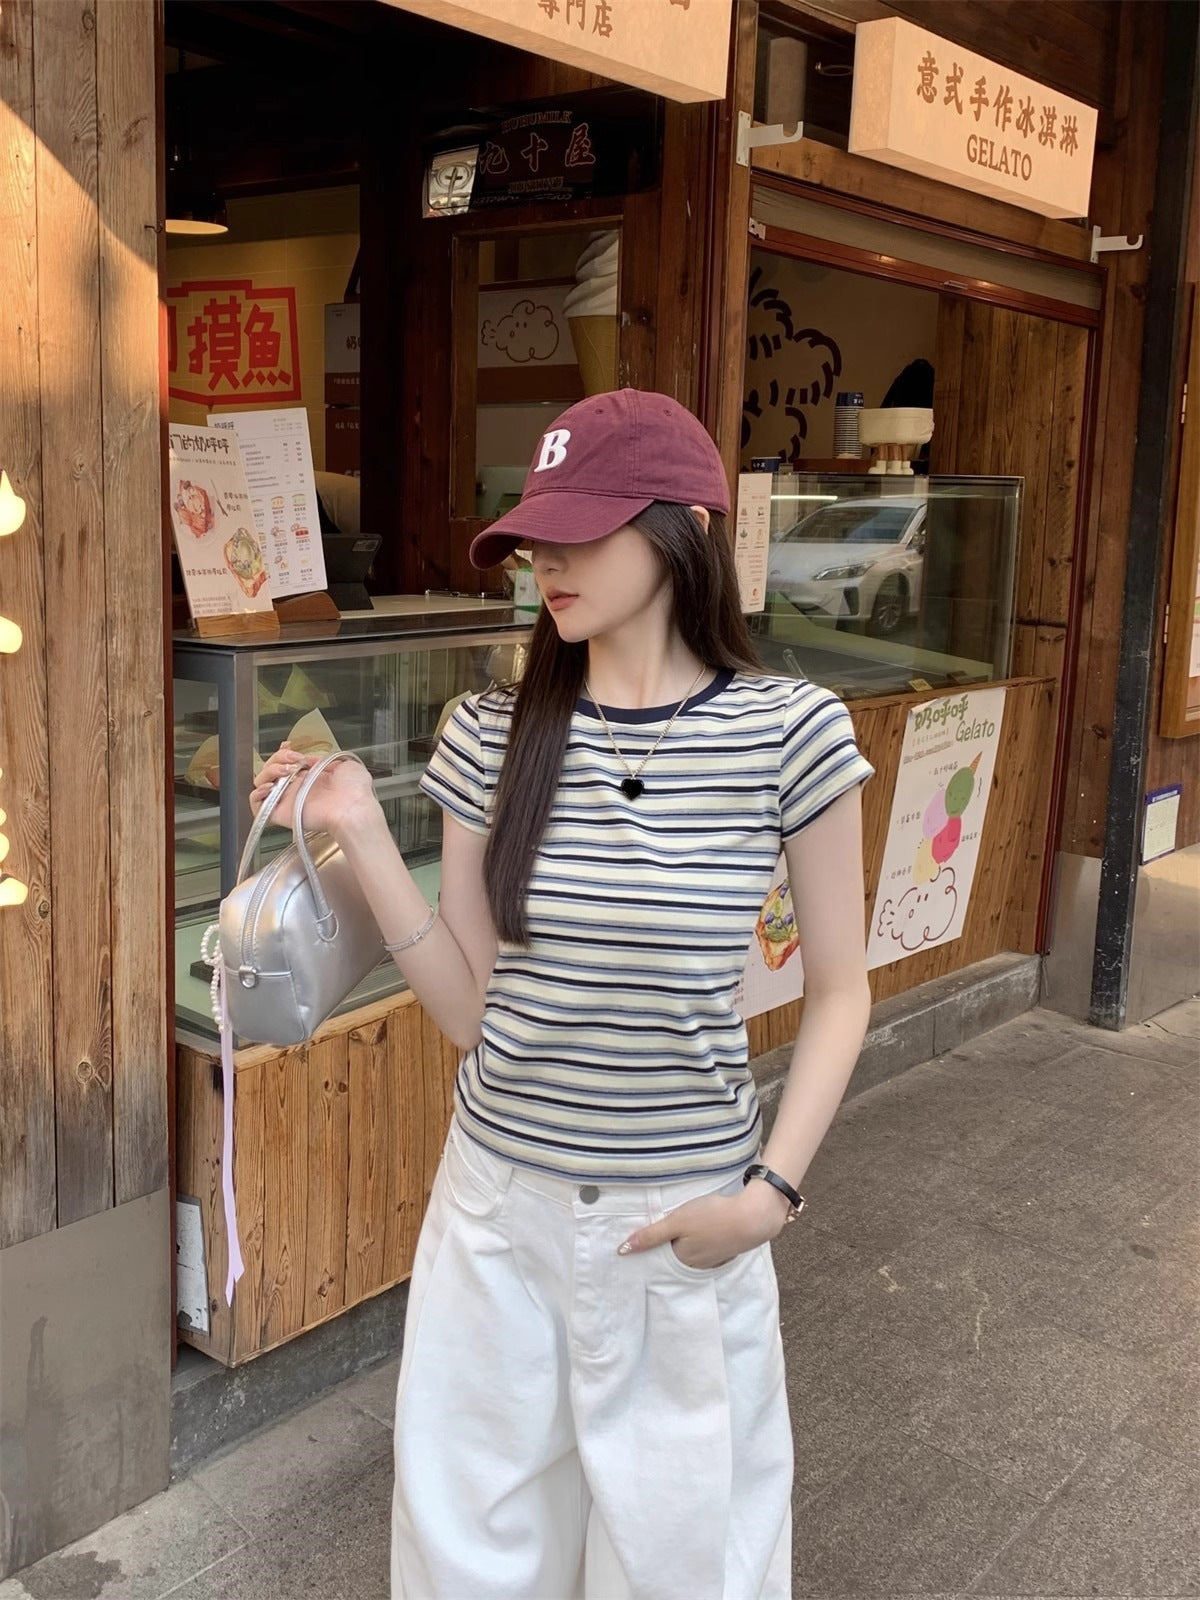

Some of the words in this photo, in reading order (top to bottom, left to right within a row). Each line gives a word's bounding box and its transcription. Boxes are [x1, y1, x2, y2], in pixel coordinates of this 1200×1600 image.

[916, 50, 1080, 158] 意式手作冰淇淋
[966, 133, 1033, 182] GELATO
[346, 335, 361, 351] 奶
[533, 428, 571, 473] B
[913, 693, 969, 732] 奶呼呼
[955, 718, 995, 743] Gelato
